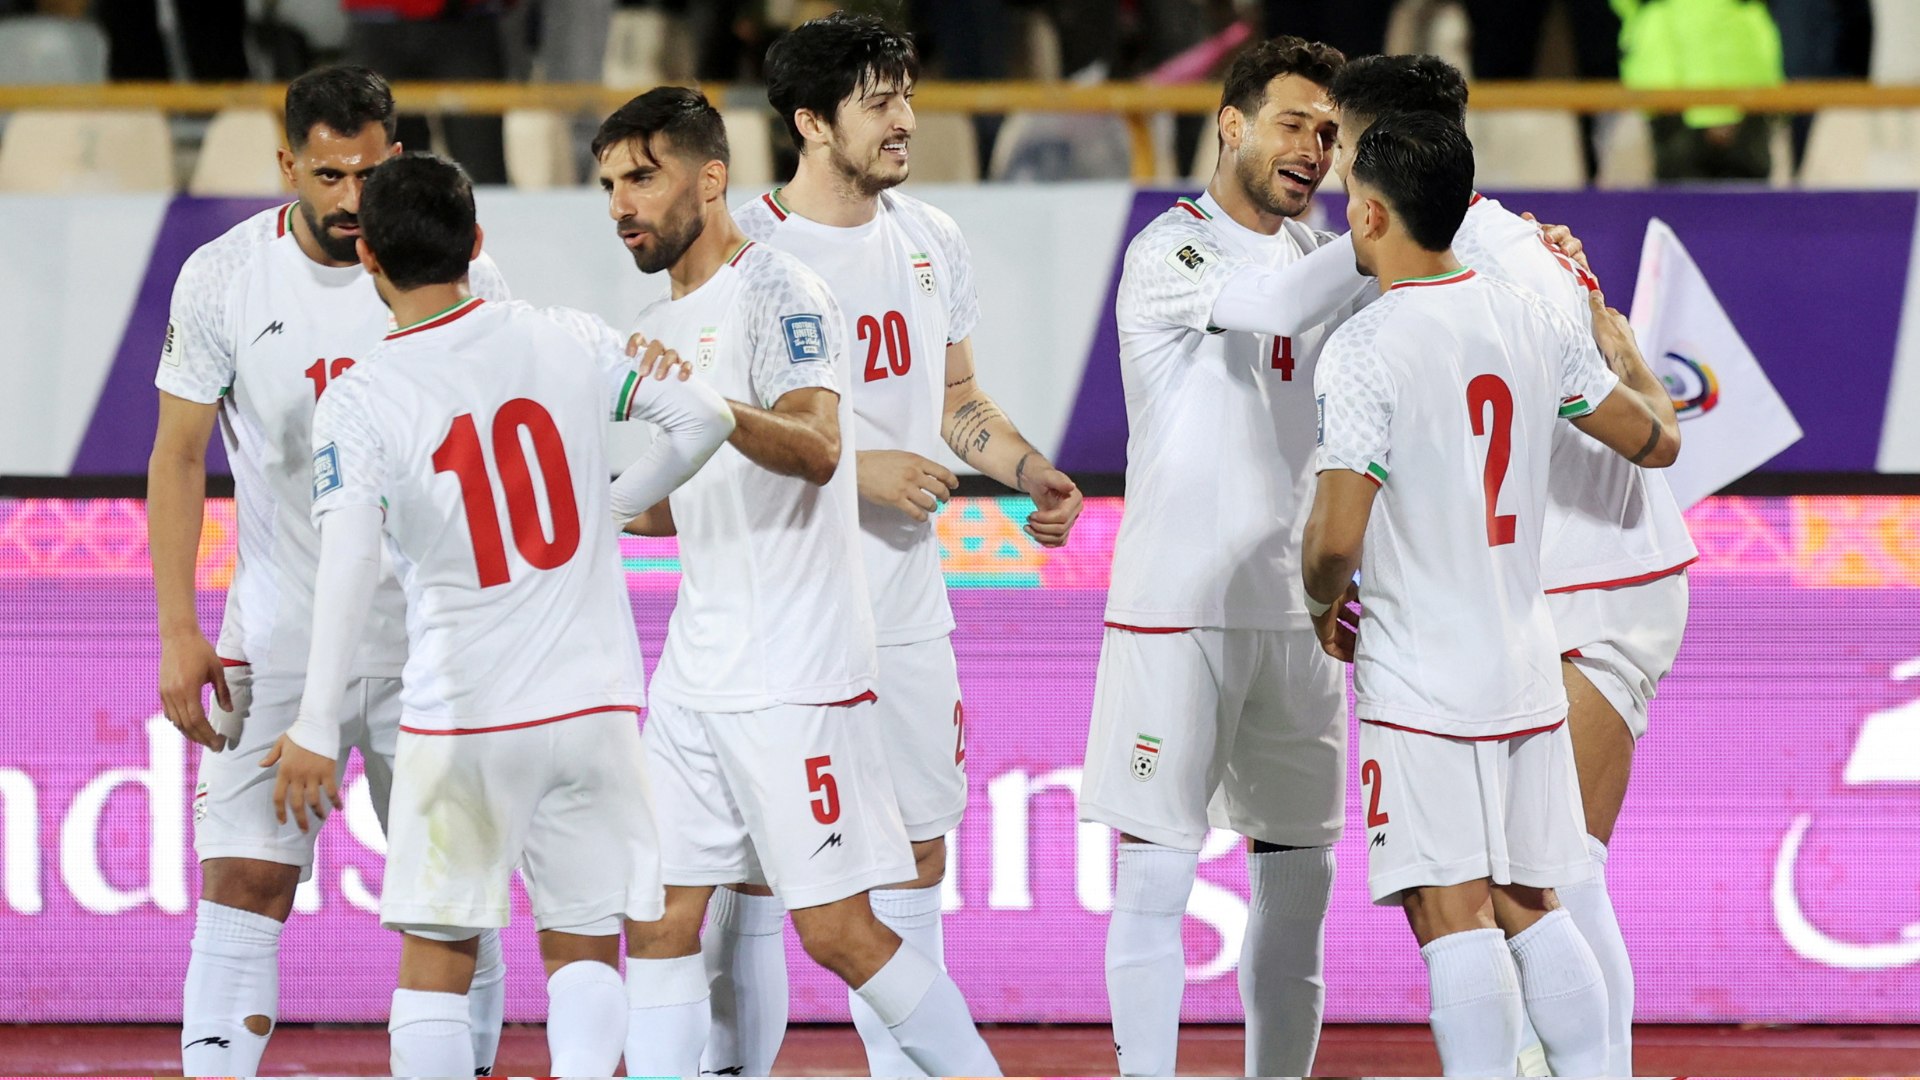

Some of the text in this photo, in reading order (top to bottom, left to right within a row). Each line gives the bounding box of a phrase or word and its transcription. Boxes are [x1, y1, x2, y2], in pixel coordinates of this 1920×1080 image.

[856, 310, 912, 382] 20
[1272, 336, 1294, 381] 4
[431, 397, 581, 589] 10
[1466, 373, 1517, 547] 2
[805, 755, 841, 825] 5
[1361, 759, 1389, 828] 2
